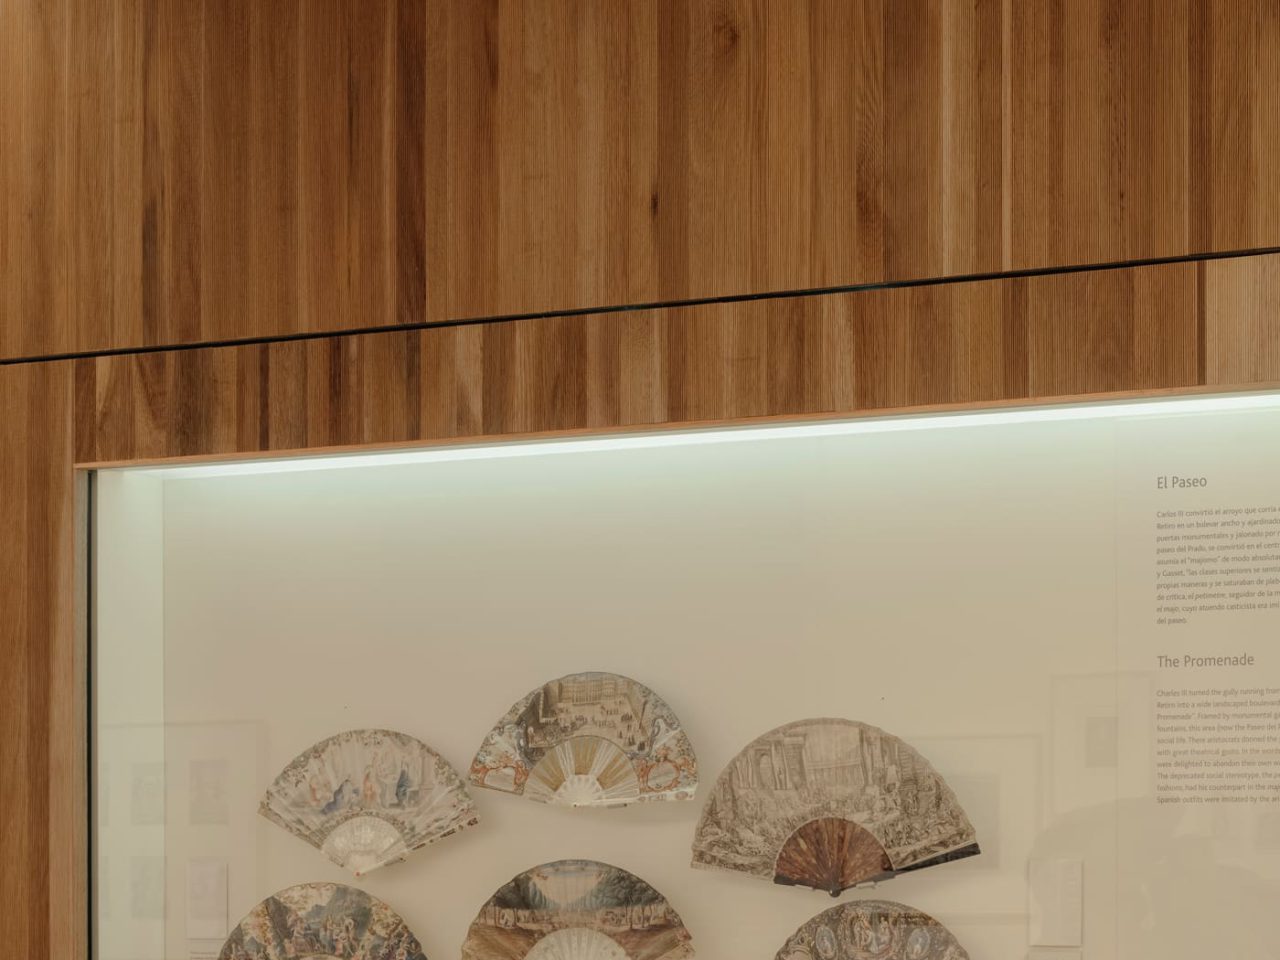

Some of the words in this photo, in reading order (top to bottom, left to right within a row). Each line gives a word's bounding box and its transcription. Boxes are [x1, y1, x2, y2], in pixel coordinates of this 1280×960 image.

[1157, 476, 1168, 489] El
[1171, 475, 1208, 489] Paseo
[1215, 507, 1221, 515] el
[1222, 508, 1243, 517] arroyo
[1244, 508, 1257, 516] que
[1156, 521, 1176, 530] Retiro
[1265, 531, 1276, 539] por
[1176, 544, 1186, 553] del
[1256, 541, 1262, 549] el
[1222, 555, 1230, 563] de
[1231, 554, 1250, 562] modo
[1199, 567, 1218, 576] clases
[1219, 566, 1252, 577] superiores
[1209, 581, 1213, 589] y
[1256, 577, 1264, 585] de
[1228, 589, 1256, 600] seguidor
[1257, 589, 1265, 597] de
[1199, 603, 1225, 611] atuendo
[1157, 616, 1166, 624] del
[1156, 655, 1180, 668] The
[1184, 652, 1255, 668] Promenade
[1223, 687, 1238, 697] gully
[1240, 686, 1264, 697] running
[1157, 795, 1181, 805] Spanish
